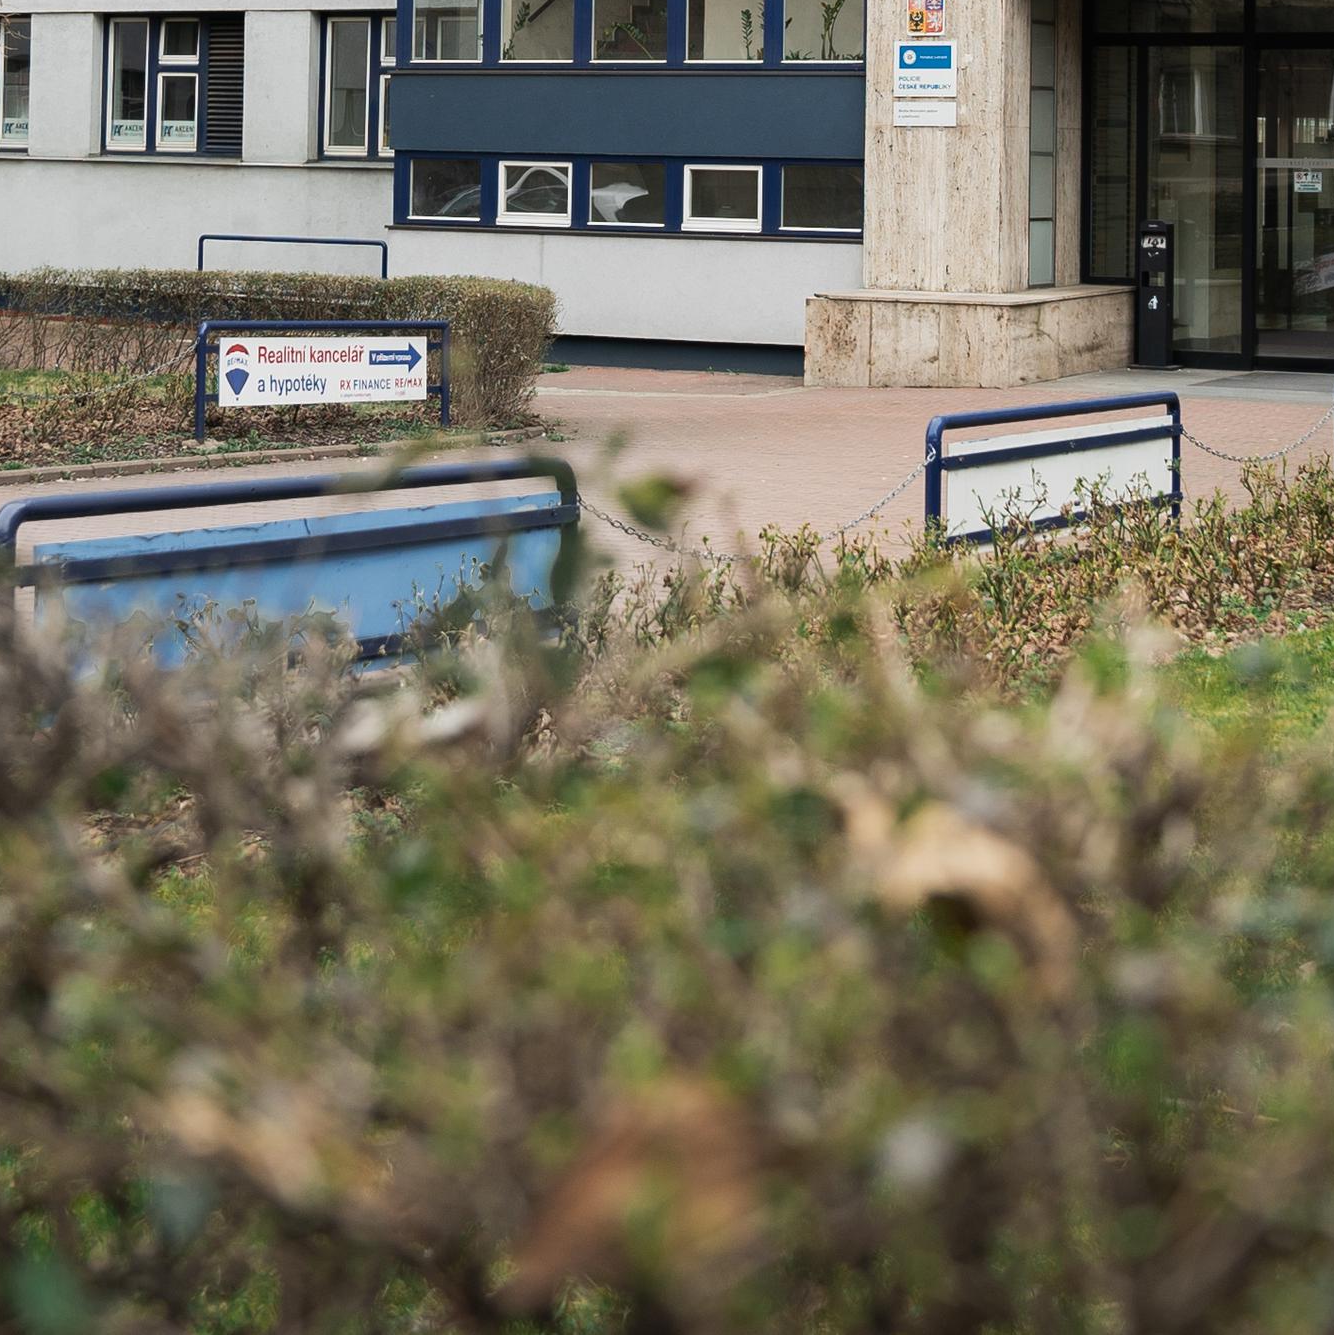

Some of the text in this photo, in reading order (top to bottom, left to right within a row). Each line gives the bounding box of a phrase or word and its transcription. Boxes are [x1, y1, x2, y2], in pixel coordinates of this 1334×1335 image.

[258, 344, 364, 364] Realitní kancelář
[257, 373, 327, 395] a hypotéky
[340, 378, 392, 390] RX FINANCE
[394, 377, 423, 388] RE/MAX
